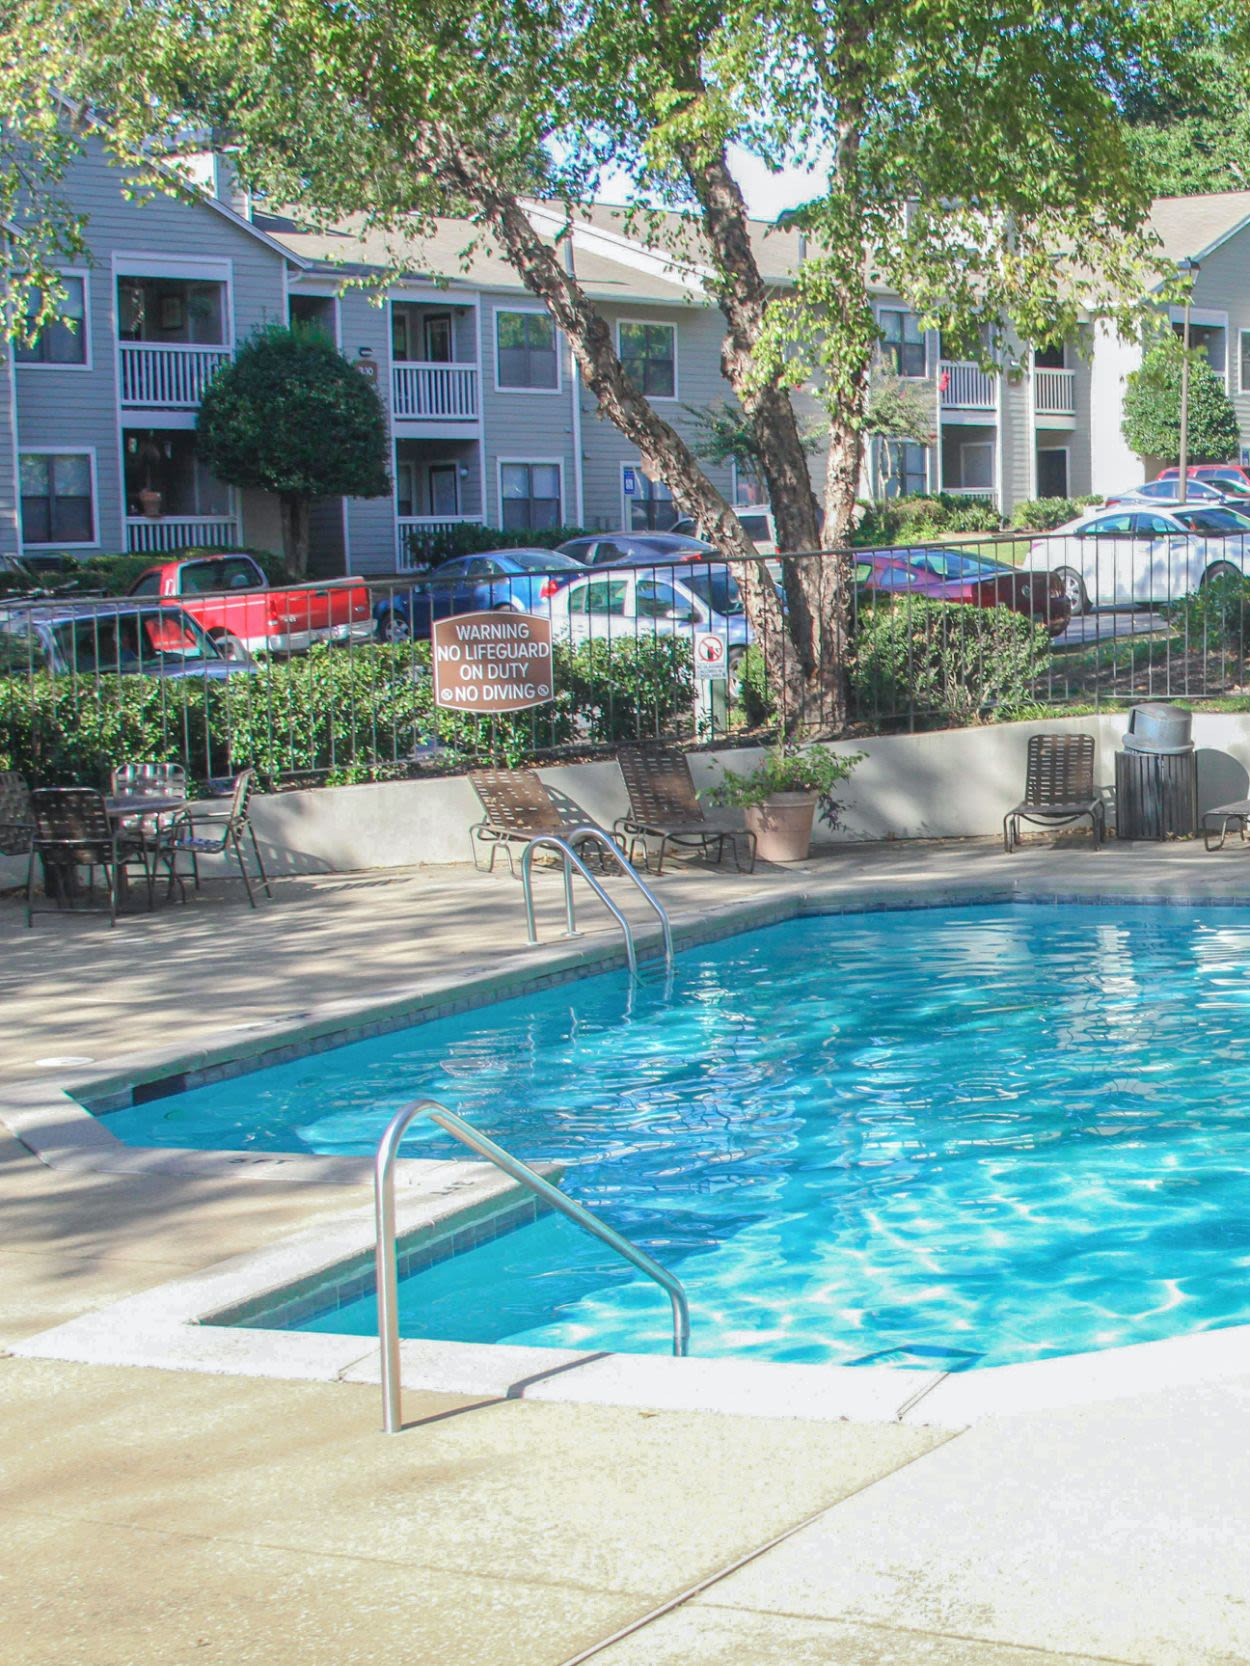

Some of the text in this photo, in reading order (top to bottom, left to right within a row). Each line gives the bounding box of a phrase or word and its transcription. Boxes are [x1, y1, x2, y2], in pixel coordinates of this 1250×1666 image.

[455, 623, 529, 640] WARNING
[437, 642, 549, 661] NO LIFEGUARD
[460, 662, 529, 680] ON DUTY
[455, 683, 536, 702] NO DIVING
